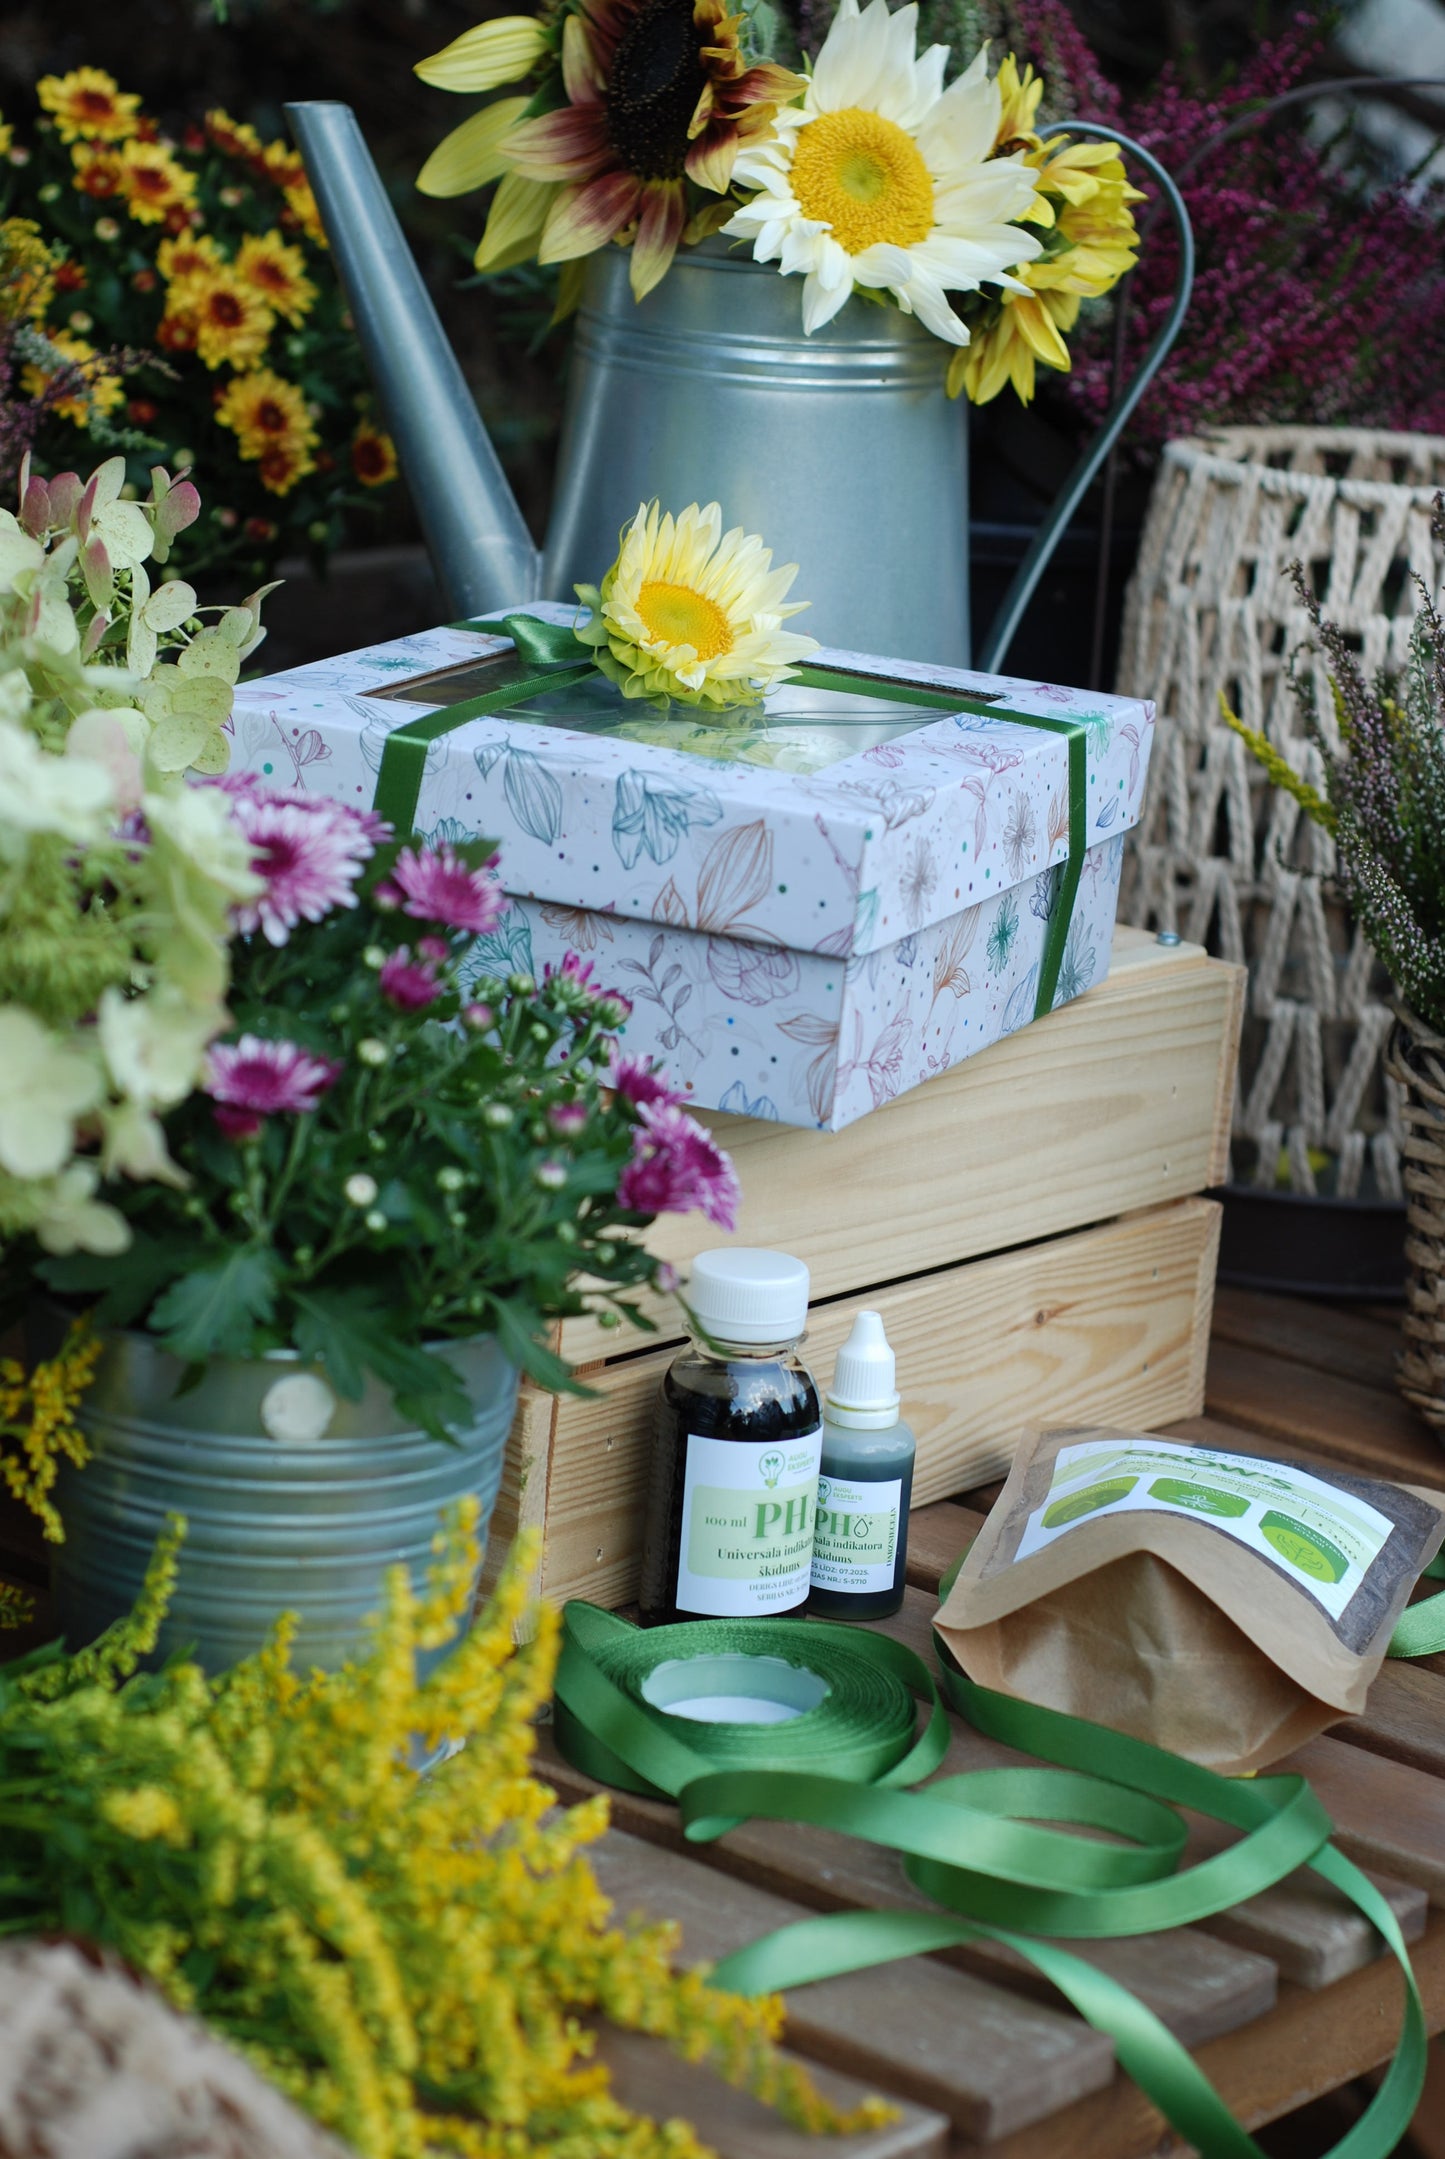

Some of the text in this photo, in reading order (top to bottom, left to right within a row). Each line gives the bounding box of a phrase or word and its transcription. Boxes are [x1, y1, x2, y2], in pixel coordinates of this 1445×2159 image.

[1124, 1449, 1293, 1490] GROW'S
[705, 1516, 747, 1527] 100 ml
[752, 1494, 809, 1539] PH
[815, 1508, 851, 1537] PH
[833, 1539, 883, 1550] indikatora
